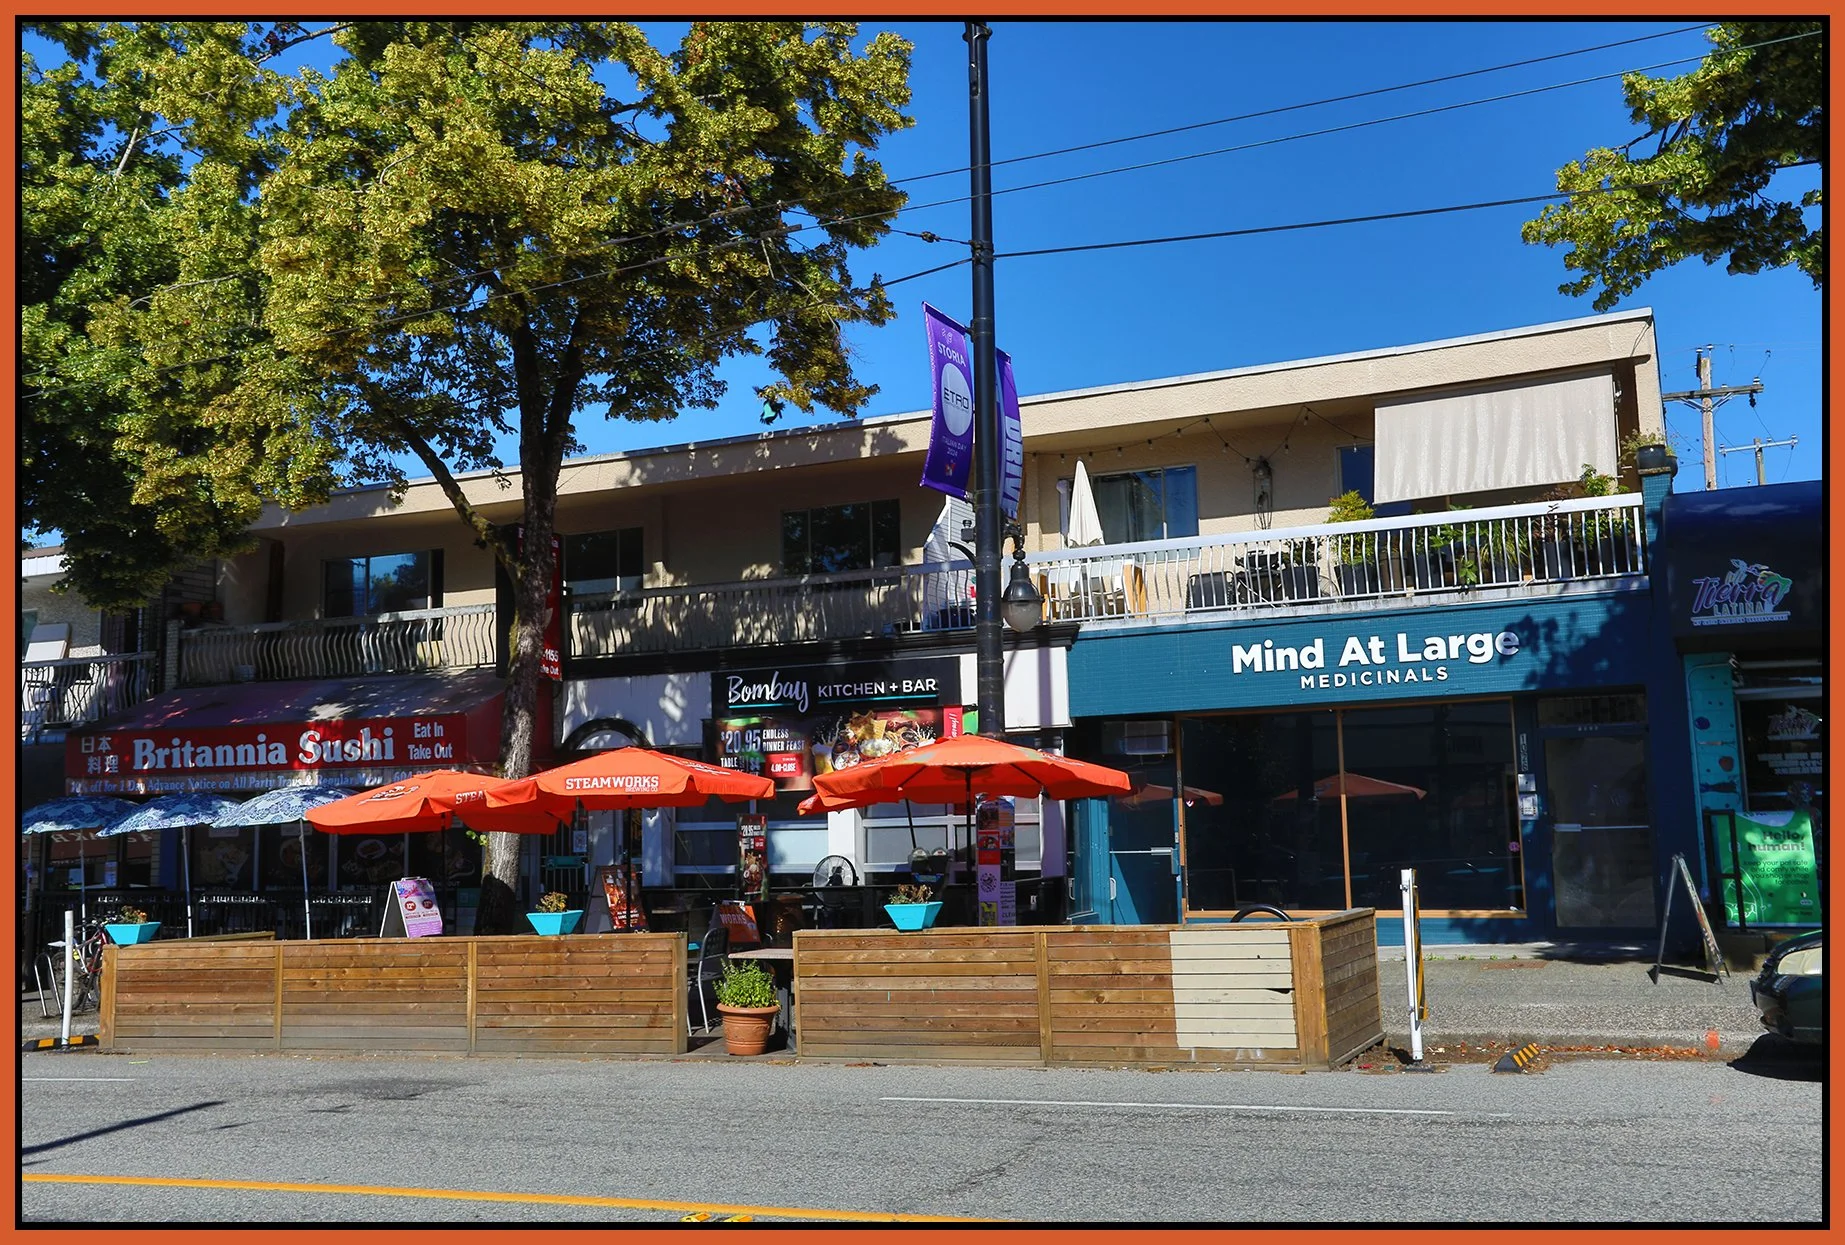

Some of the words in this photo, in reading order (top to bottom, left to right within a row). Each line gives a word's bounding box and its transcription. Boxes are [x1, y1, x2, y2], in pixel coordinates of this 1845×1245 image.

[937, 341, 967, 367] STORIA
[943, 387, 970, 410] ETRO
[1692, 576, 1781, 614] Tierra
[1713, 601, 1764, 616] LATINA
[1231, 638, 1325, 674] Mind
[1338, 635, 1386, 667] At
[1396, 631, 1520, 664] Large
[1300, 666, 1449, 689] MEDICINALS
[726, 670, 808, 712] Bombay
[818, 682, 886, 698] KITCHEN
[889, 682, 898, 692] +
[902, 678, 938, 693] BAR
[414, 722, 431, 738] Eat
[434, 722, 444, 737] In
[81, 736, 112, 754] 日本
[132, 733, 288, 770] Britannia
[298, 727, 395, 764] Sushi
[721, 729, 761, 753] $20.95
[762, 729, 789, 739] ENDLESS
[762, 741, 785, 751] DINNER
[786, 740, 805, 751] FEAST
[407, 744, 431, 760] Take
[434, 742, 453, 758] Out
[87, 754, 119, 774] 料理
[720, 757, 738, 767] TABLE
[104, 780, 117, 791] for
[127, 780, 145, 794] Day
[147, 779, 185, 791] Advance
[188, 778, 216, 790] Notice
[218, 779, 230, 788] on
[233, 777, 247, 789] All
[248, 776, 275, 791] Party
[304, 774, 313, 786] &
[318, 774, 353, 787] Regular
[565, 775, 660, 790] STEAMWORKS
[1763, 830, 1805, 841] Hello,
[1748, 841, 1805, 851] human!
[719, 913, 747, 925] WORKS
